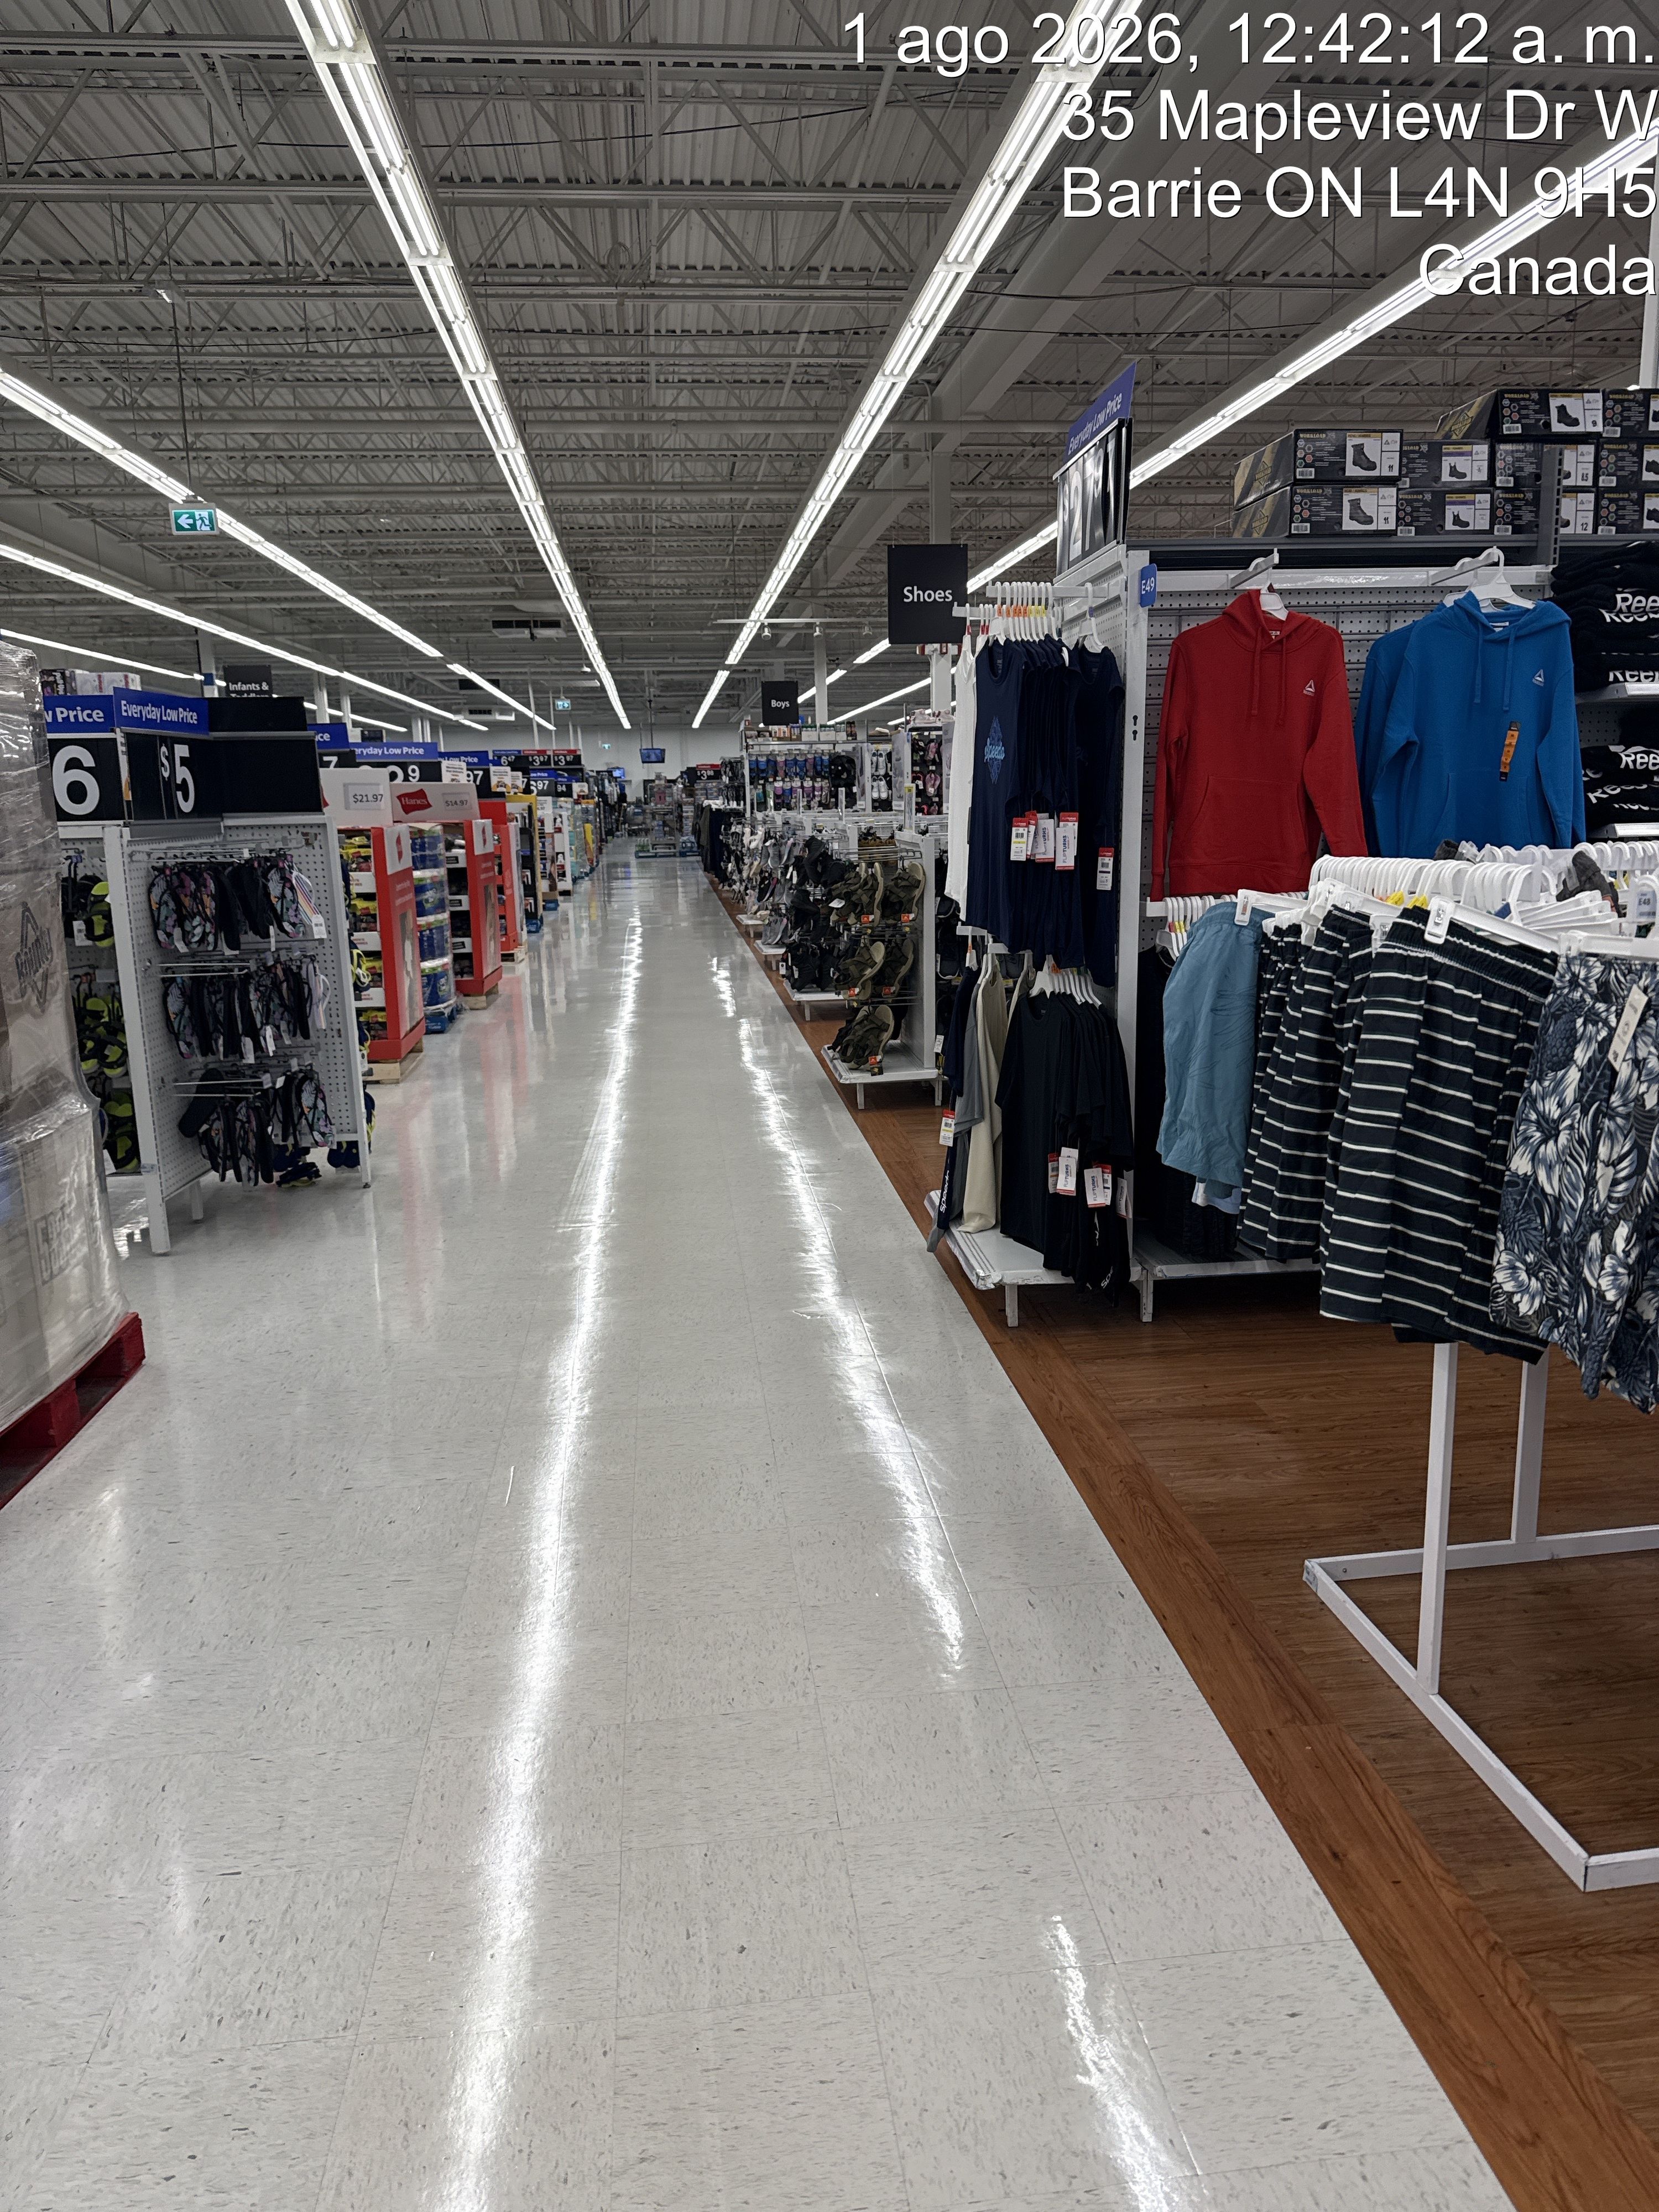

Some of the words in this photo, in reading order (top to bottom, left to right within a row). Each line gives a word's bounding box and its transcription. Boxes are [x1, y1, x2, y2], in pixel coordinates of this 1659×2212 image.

[1068, 420, 1094, 455] Everyday
[1093, 408, 1107, 432] Low
[1105, 393, 1122, 420] Price
[1580, 522, 1588, 531] 12
[1141, 577, 1155, 594] E49
[903, 586, 953, 602] Shoes
[228, 682, 260, 691] Infants
[261, 681, 269, 691] &
[771, 699, 790, 709] Boys
[55, 706, 105, 723] Price
[121, 700, 161, 723] Everyday
[161, 706, 178, 722] Low
[178, 707, 198, 724] Price
[354, 747, 383, 756] eryday
[52, 745, 100, 816] 6
[352, 794, 383, 804] $21.97
[401, 797, 427, 805] Hanes
